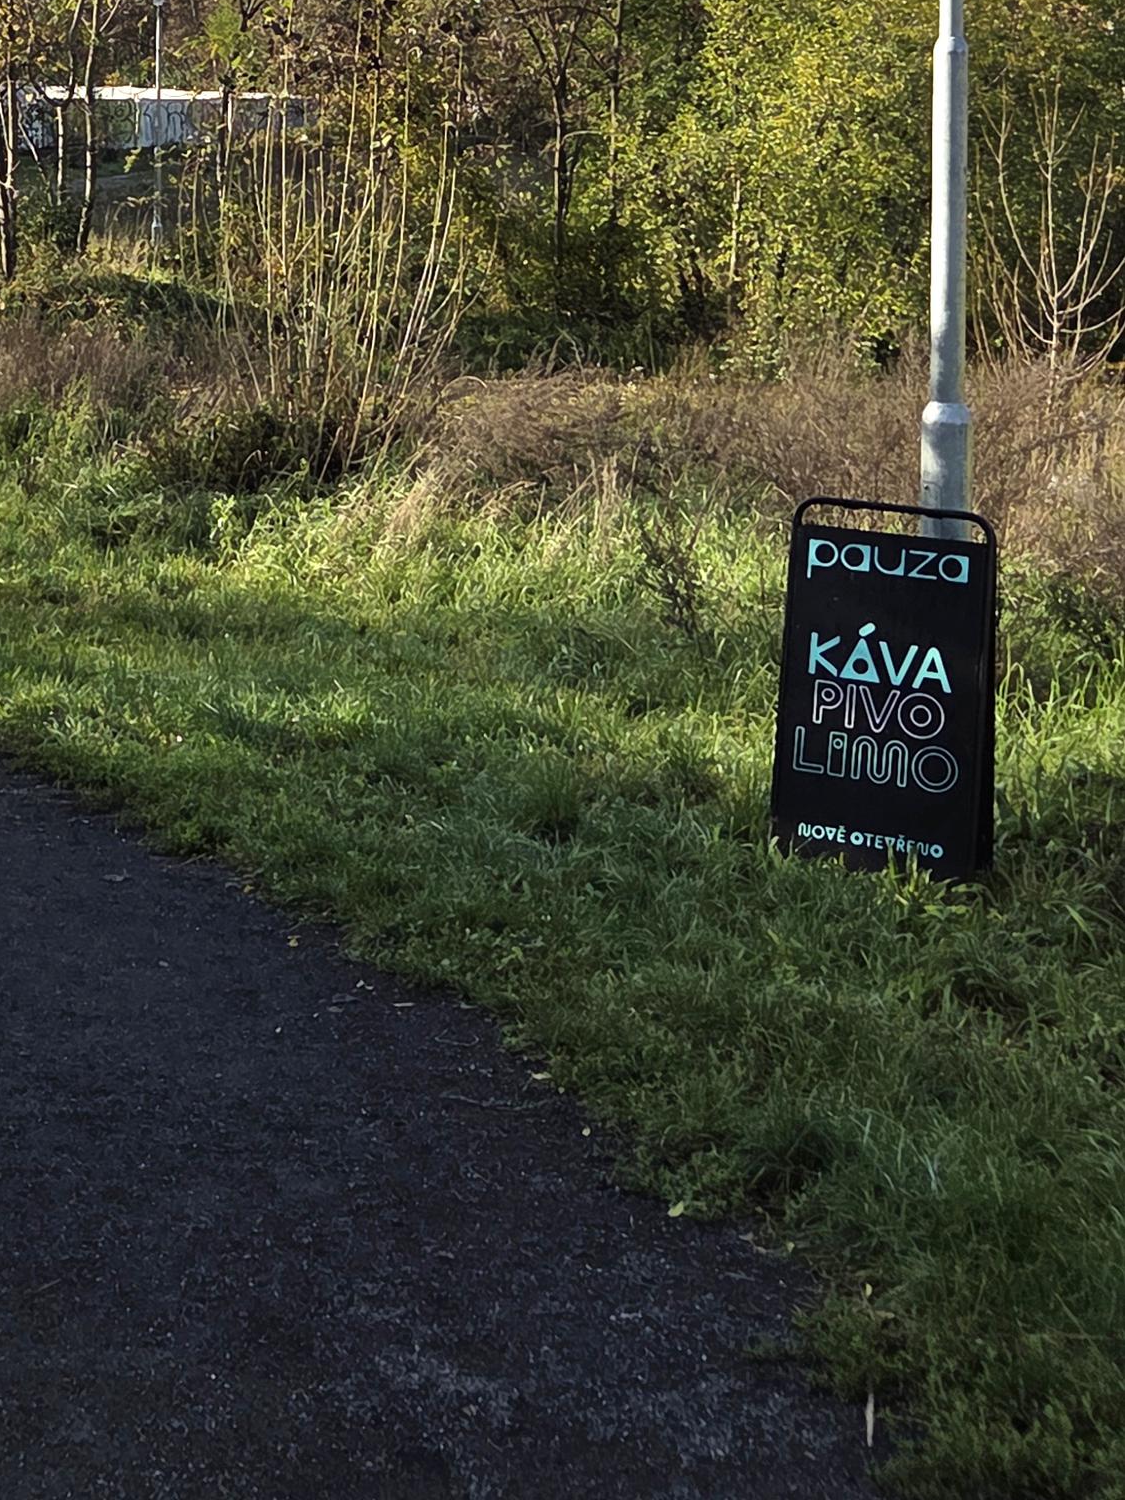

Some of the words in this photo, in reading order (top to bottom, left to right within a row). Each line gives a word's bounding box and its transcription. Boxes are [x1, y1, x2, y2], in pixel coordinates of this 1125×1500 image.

[807, 538, 970, 584] pauza
[808, 622, 952, 694] KÁVA
[812, 679, 946, 740] PIVO
[798, 822, 847, 843] NOVĚ
[850, 832, 944, 858] OTEVŘENO
